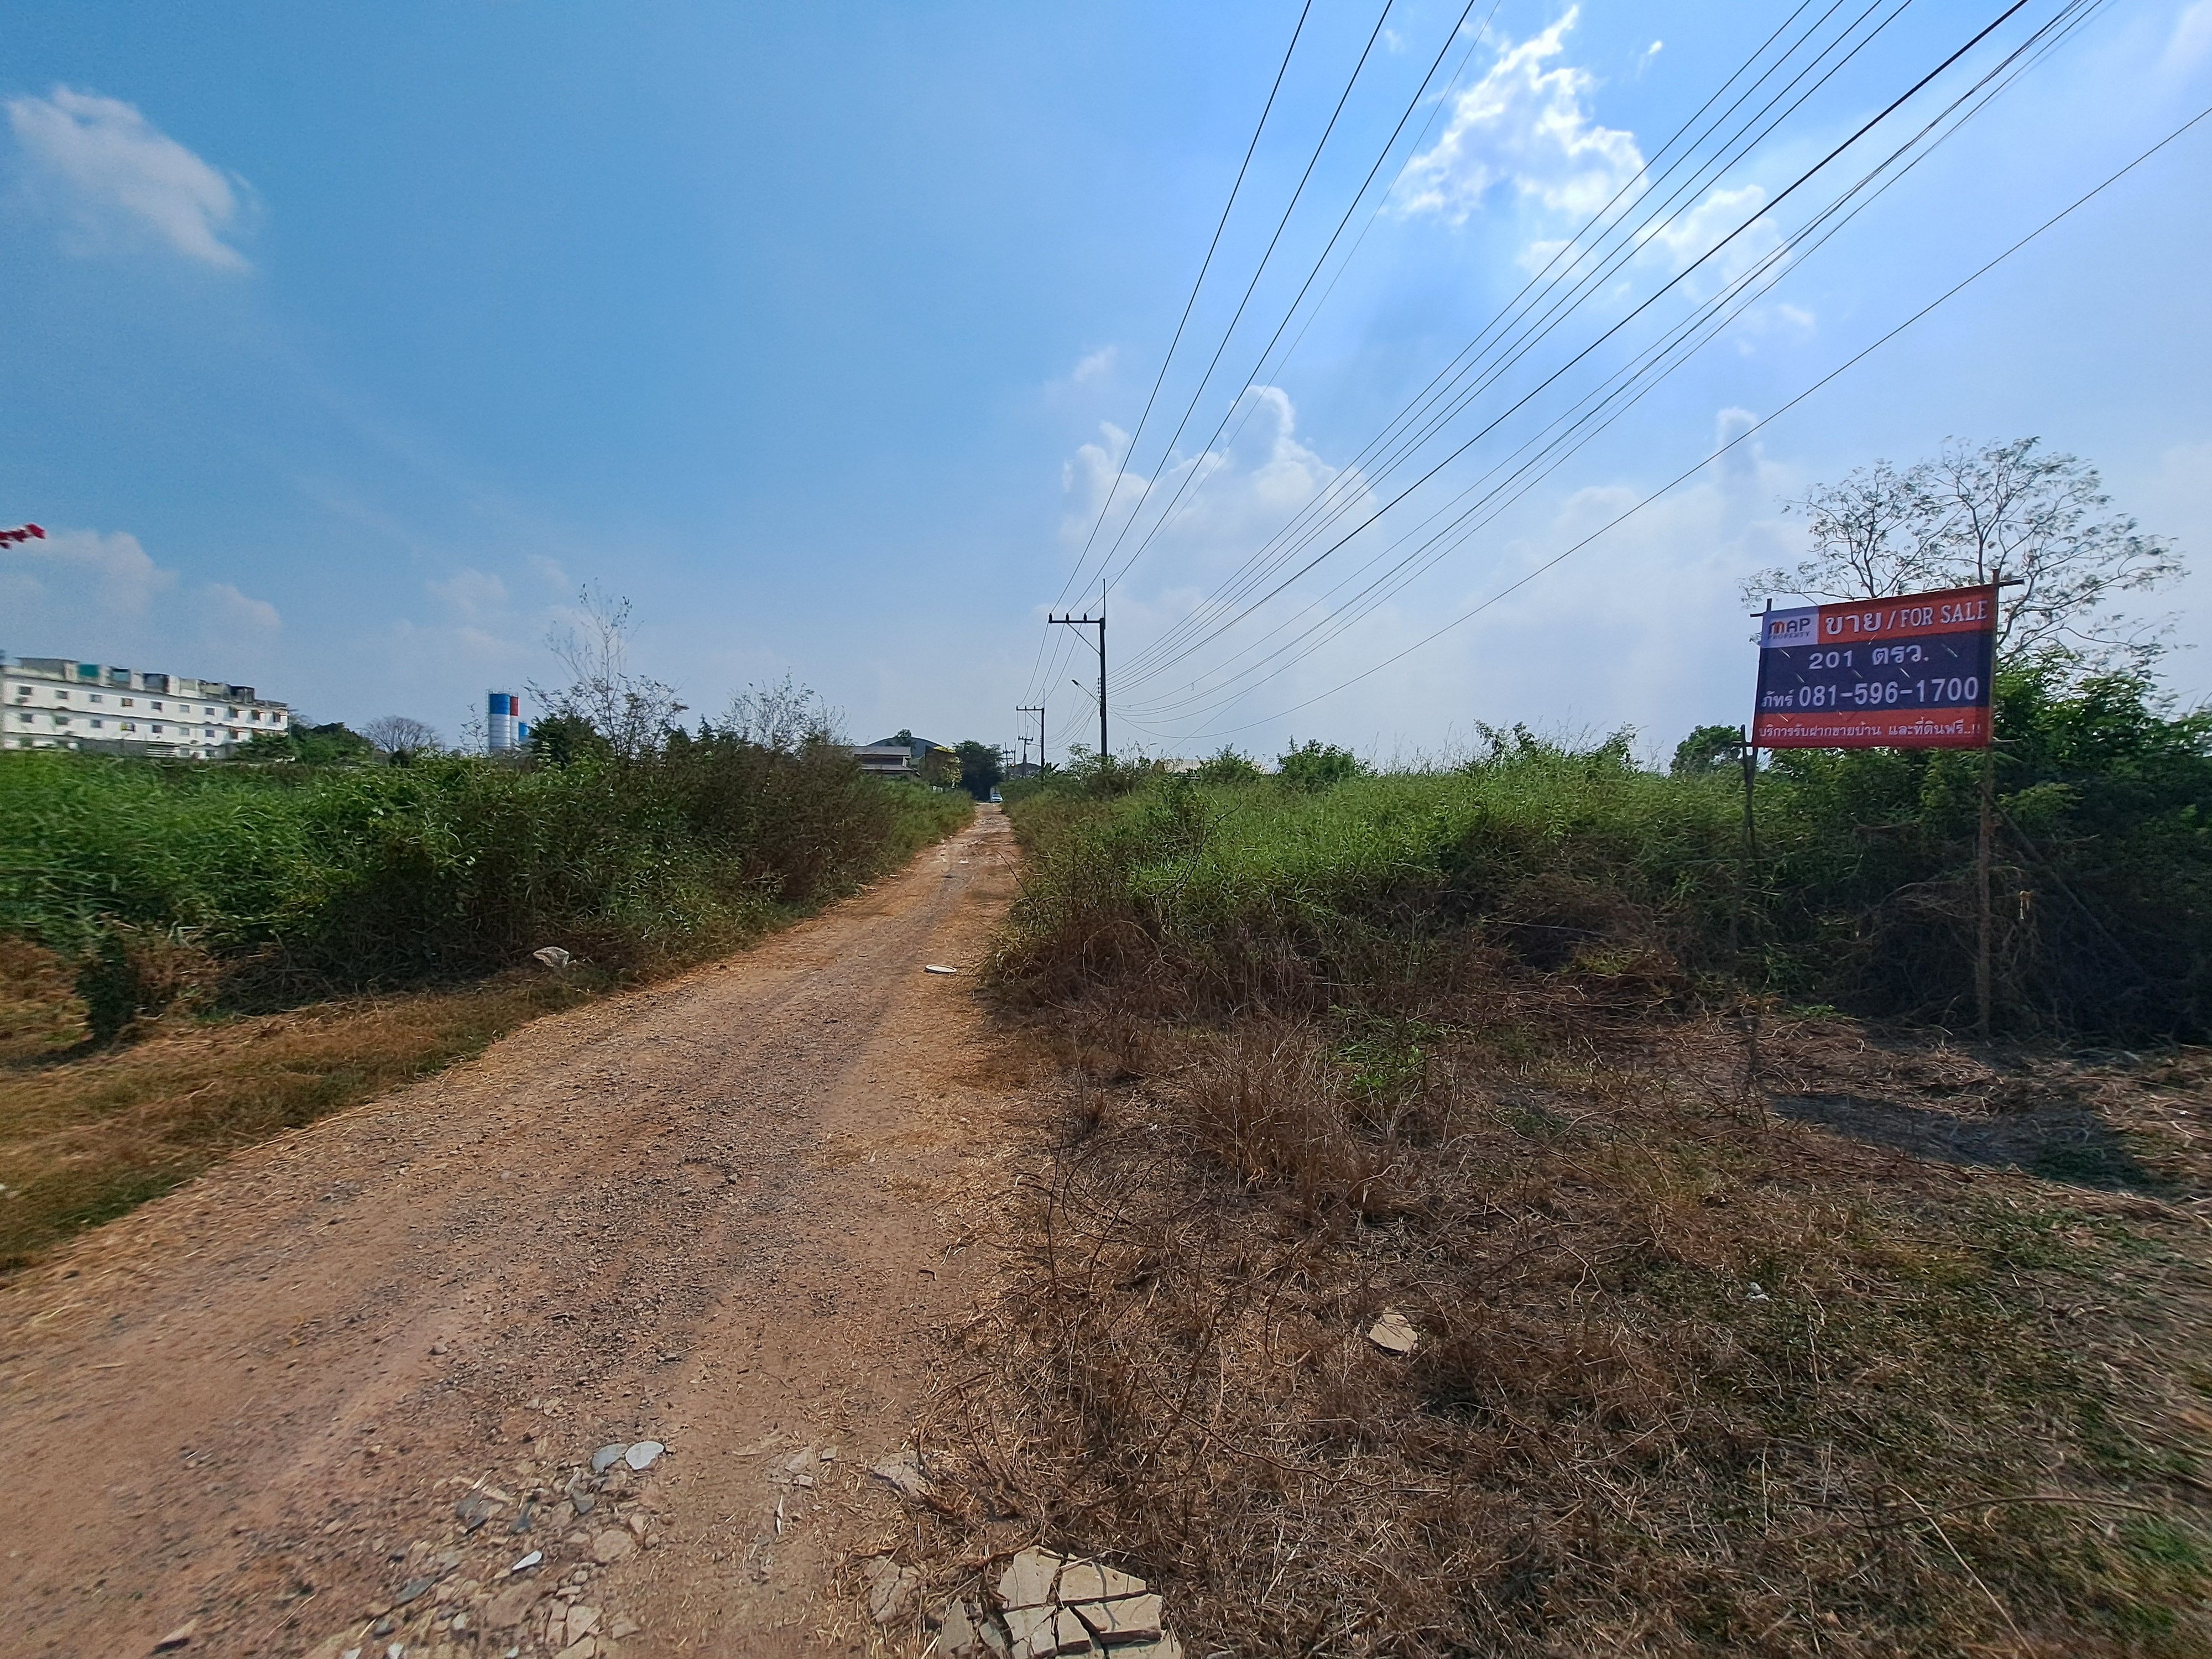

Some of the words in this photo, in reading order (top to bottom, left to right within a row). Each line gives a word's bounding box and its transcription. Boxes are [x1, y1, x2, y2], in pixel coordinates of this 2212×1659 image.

[1825, 612, 1882, 635] ขาย
[1900, 607, 1933, 628] FOR
[1940, 599, 1988, 624] SALE
[1808, 650, 1853, 670] 201
[1872, 644, 1929, 666] ตรว.
[1798, 676, 1979, 707] 081-596-1700
